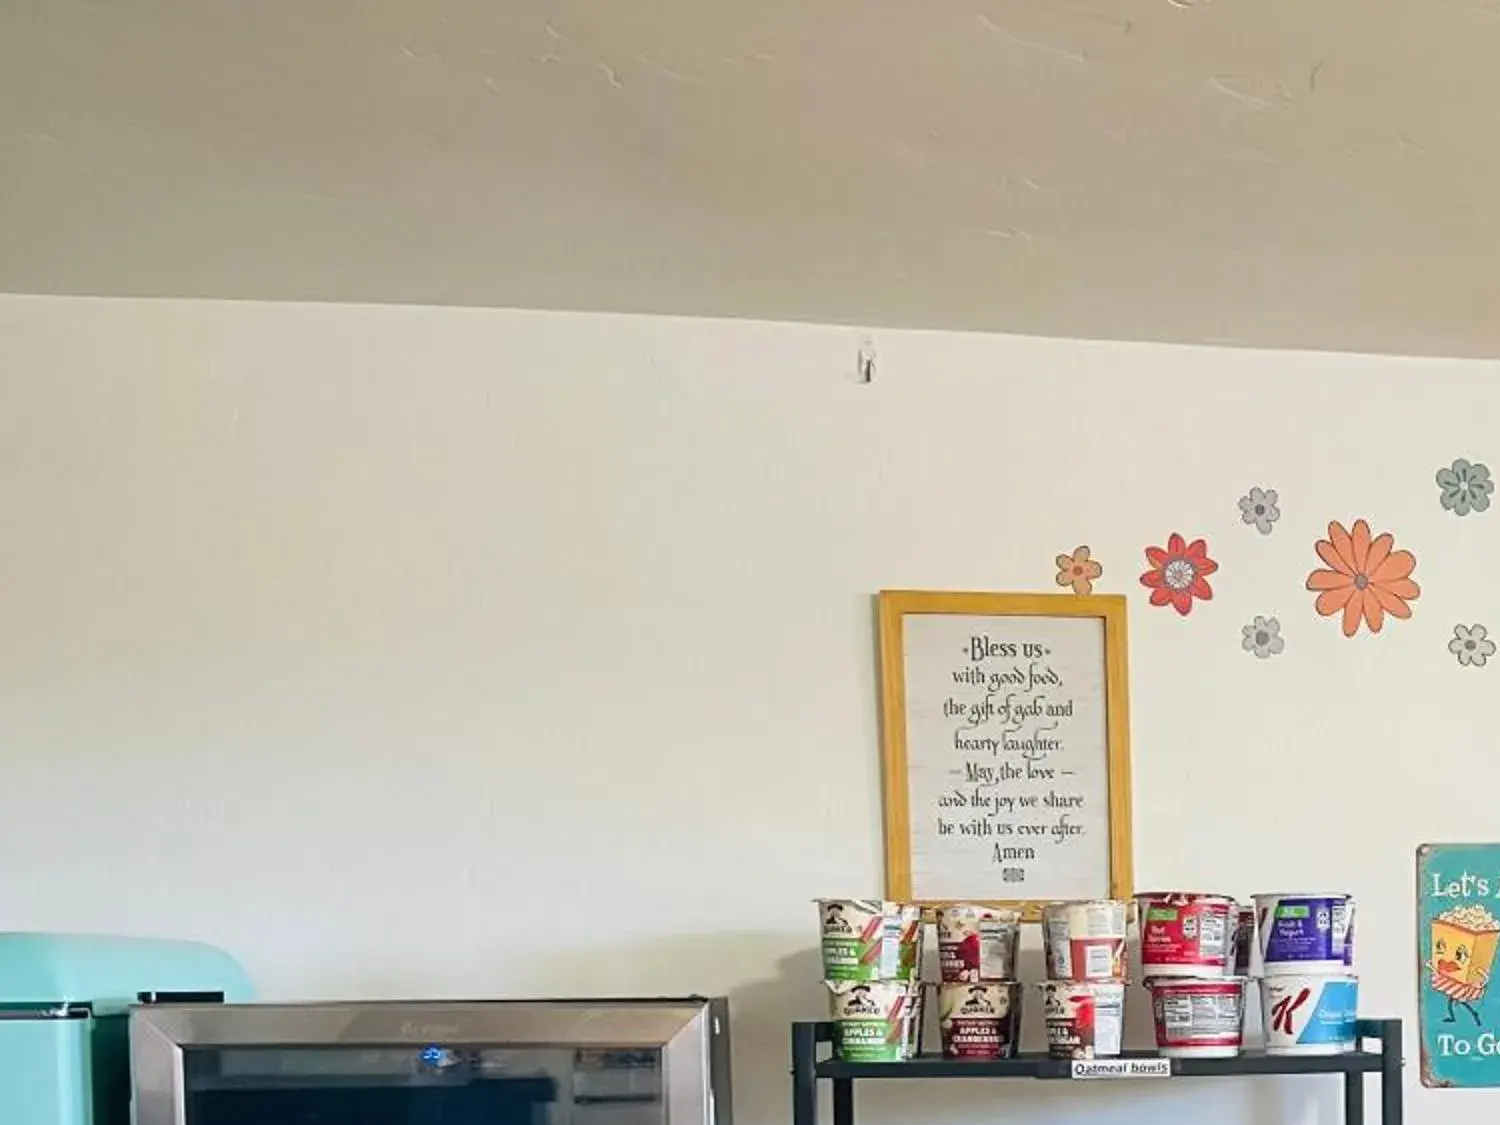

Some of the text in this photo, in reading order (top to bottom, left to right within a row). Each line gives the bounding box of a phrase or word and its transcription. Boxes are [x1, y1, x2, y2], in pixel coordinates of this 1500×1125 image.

[970, 635, 1043, 661] Bless us
[952, 662, 1063, 693] with good food,
[944, 693, 1073, 725] the gift of gab and
[954, 724, 1064, 760] hearty laughter.
[1000, 763, 1022, 781] the
[1027, 758, 1054, 781] love
[939, 786, 1084, 817] and the joy we share
[938, 818, 954, 836] be
[959, 820, 993, 837] with
[997, 824, 1013, 836] us
[1018, 824, 1048, 836] ever
[992, 843, 1036, 864] Amen
[1431, 872, 1490, 898] Let's
[1271, 987, 1311, 1035] K
[1438, 1033, 1472, 1057] To
[1074, 1061, 1168, 1075] Oatmeal bowls
